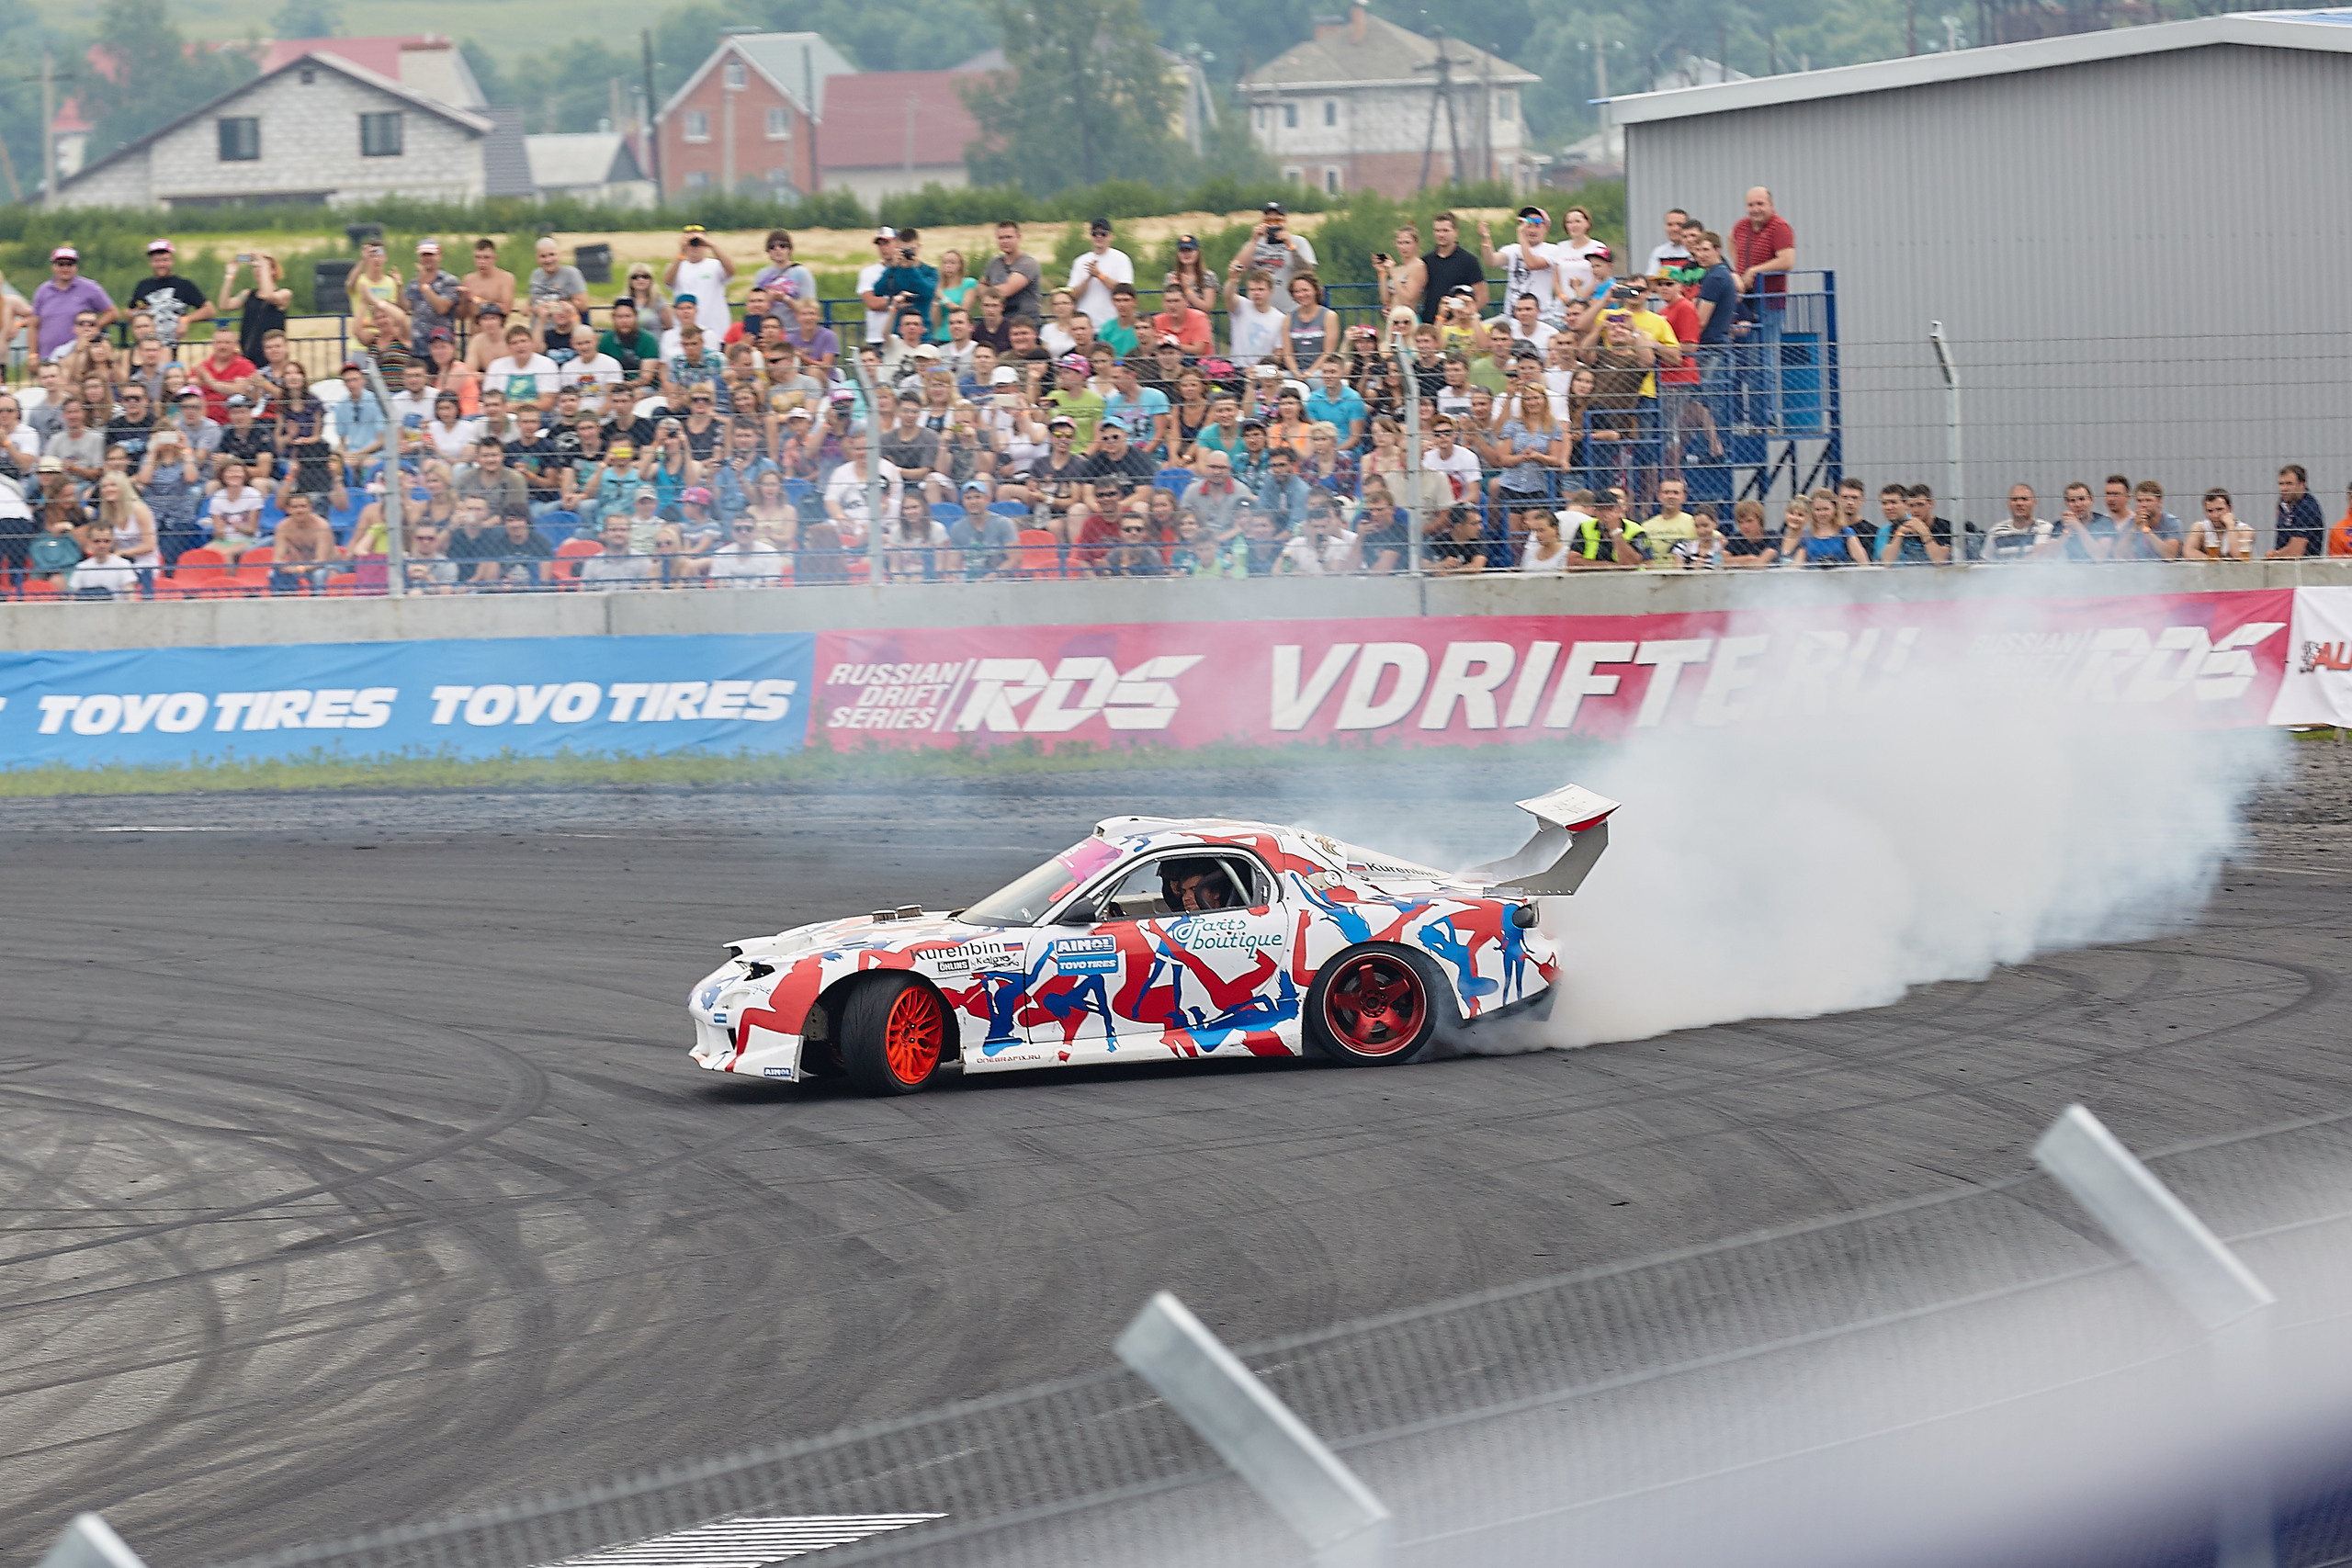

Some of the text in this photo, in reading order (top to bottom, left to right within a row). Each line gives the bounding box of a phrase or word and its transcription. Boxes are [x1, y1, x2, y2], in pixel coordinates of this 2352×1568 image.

[827, 661, 962, 685] RUSSIAN
[431, 679, 797, 726] TOYO TIRES
[858, 684, 951, 707] DRIFT
[952, 655, 1206, 732] RDS
[38, 687, 399, 736] TOYO TIRES
[829, 706, 935, 730] SERIES
[1176, 918, 1247, 941] Parts
[910, 942, 1001, 961] Kurenbin
[1192, 930, 1283, 959] boutique
[1059, 959, 1116, 970] TOYO TIRES
